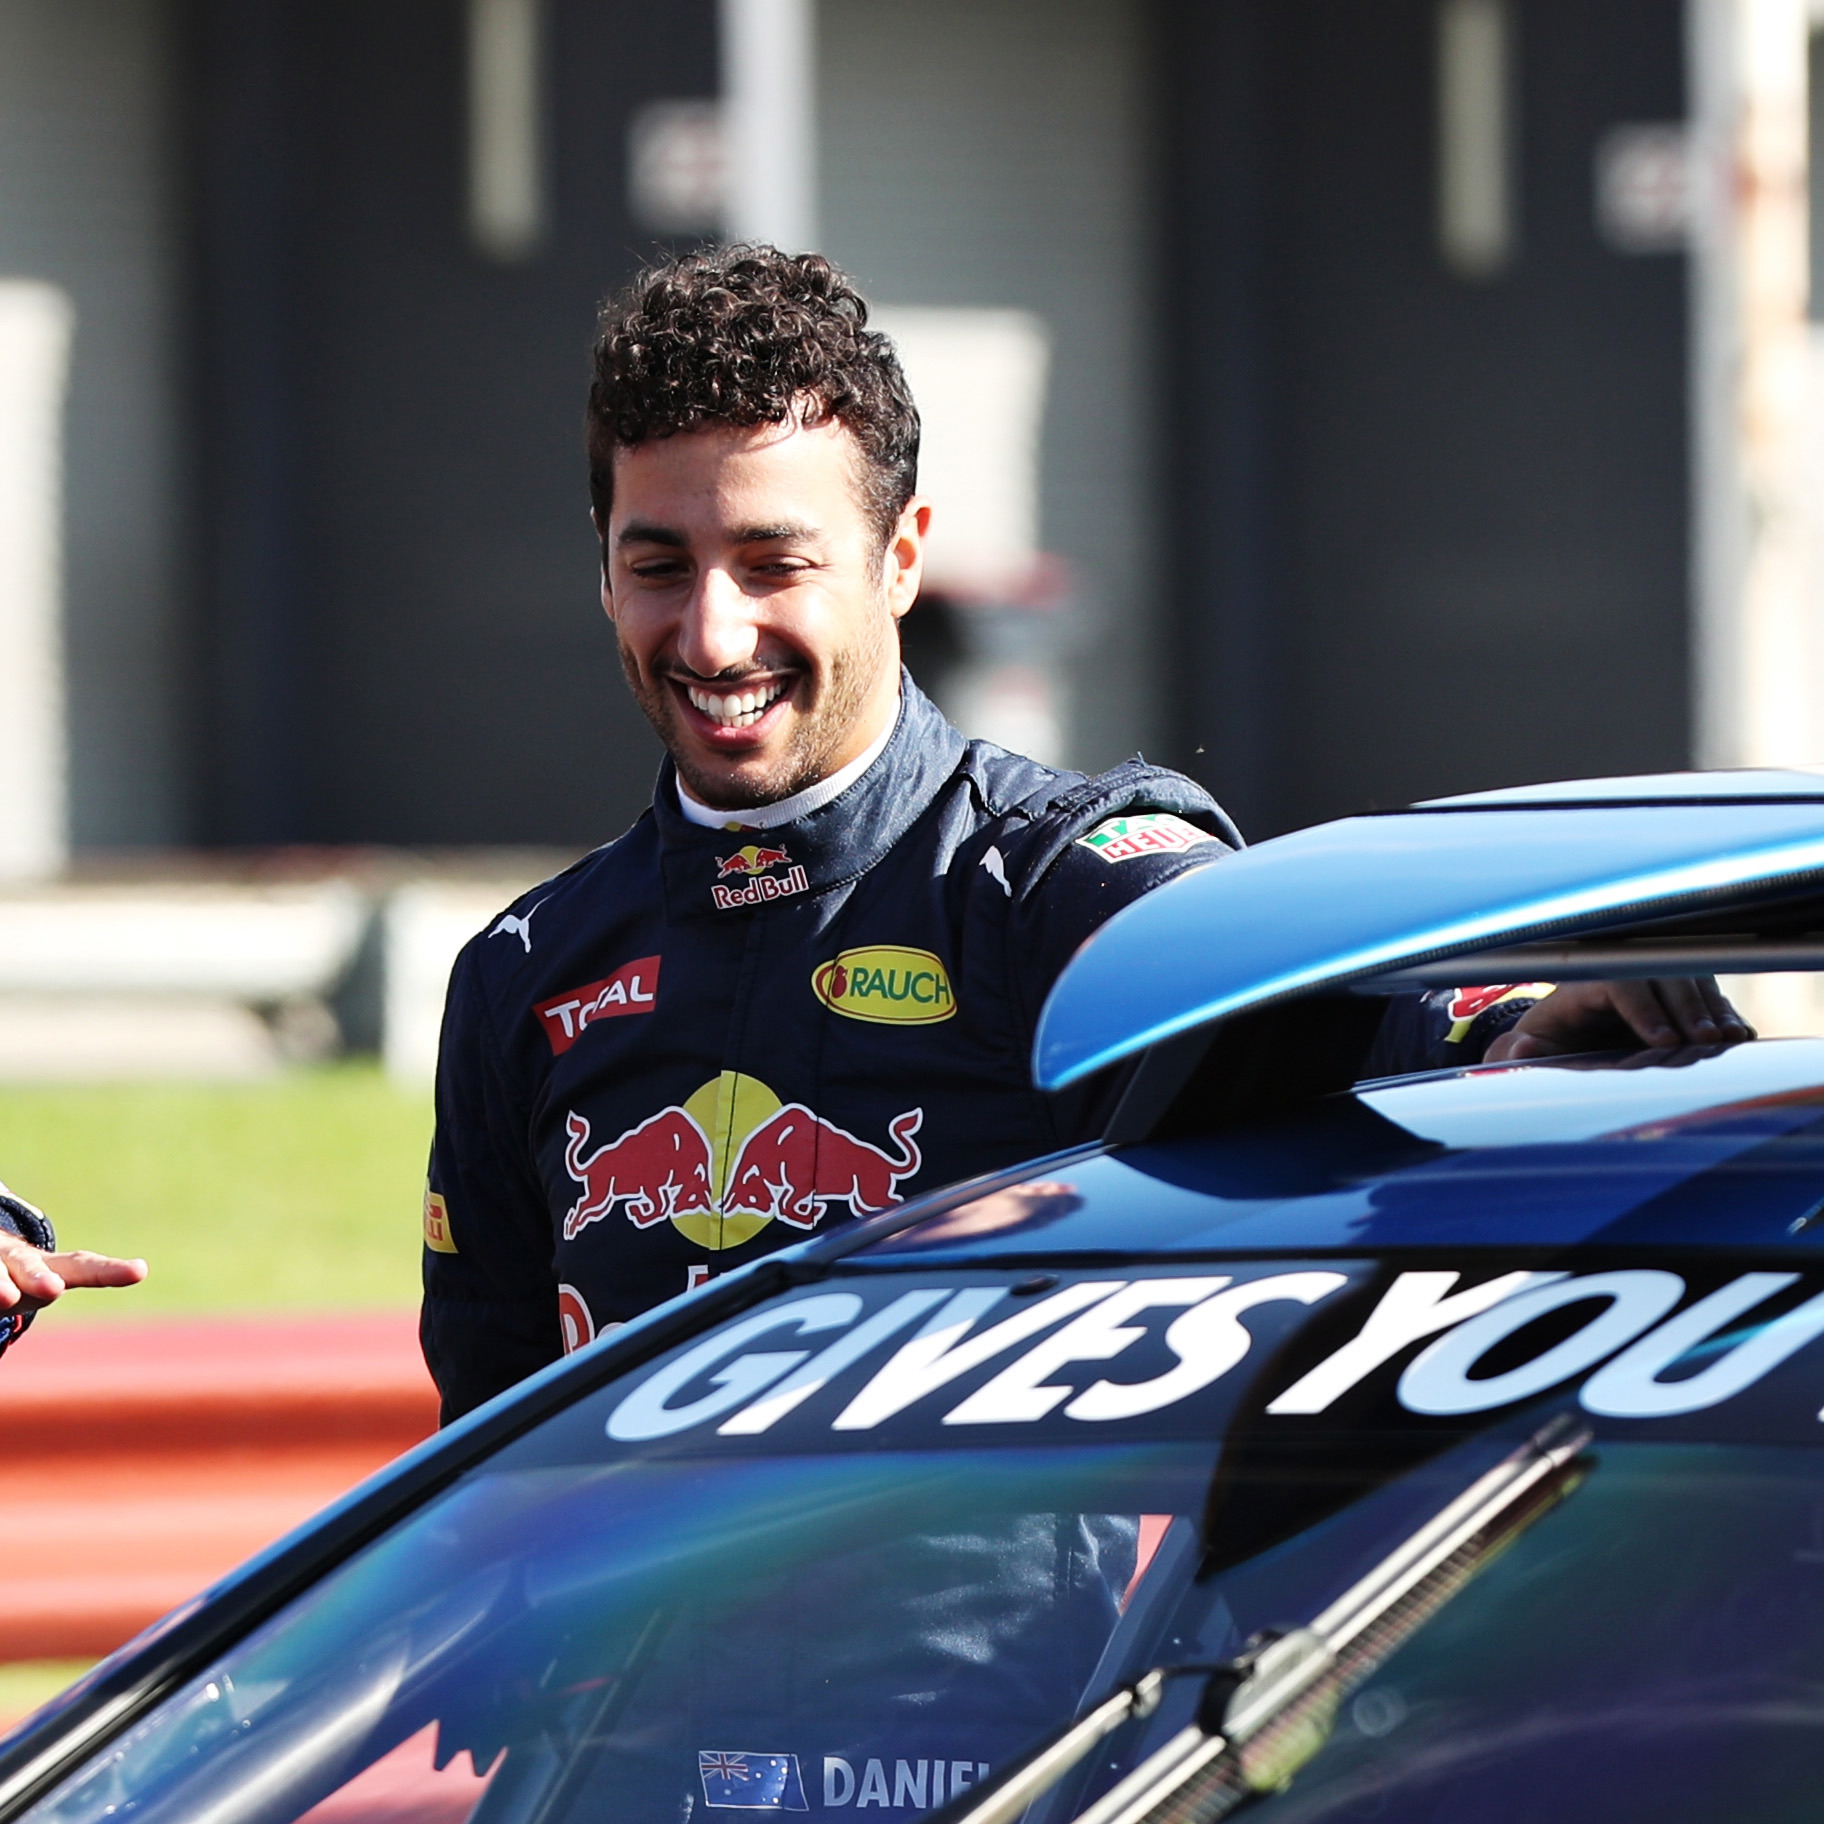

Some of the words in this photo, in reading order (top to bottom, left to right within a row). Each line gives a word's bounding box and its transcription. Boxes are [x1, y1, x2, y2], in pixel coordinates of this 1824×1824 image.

[711, 874, 761, 909] Red
[762, 865, 809, 900] Bull
[850, 967, 951, 1005] RAUCH
[606, 1271, 1349, 1441] GIVES
